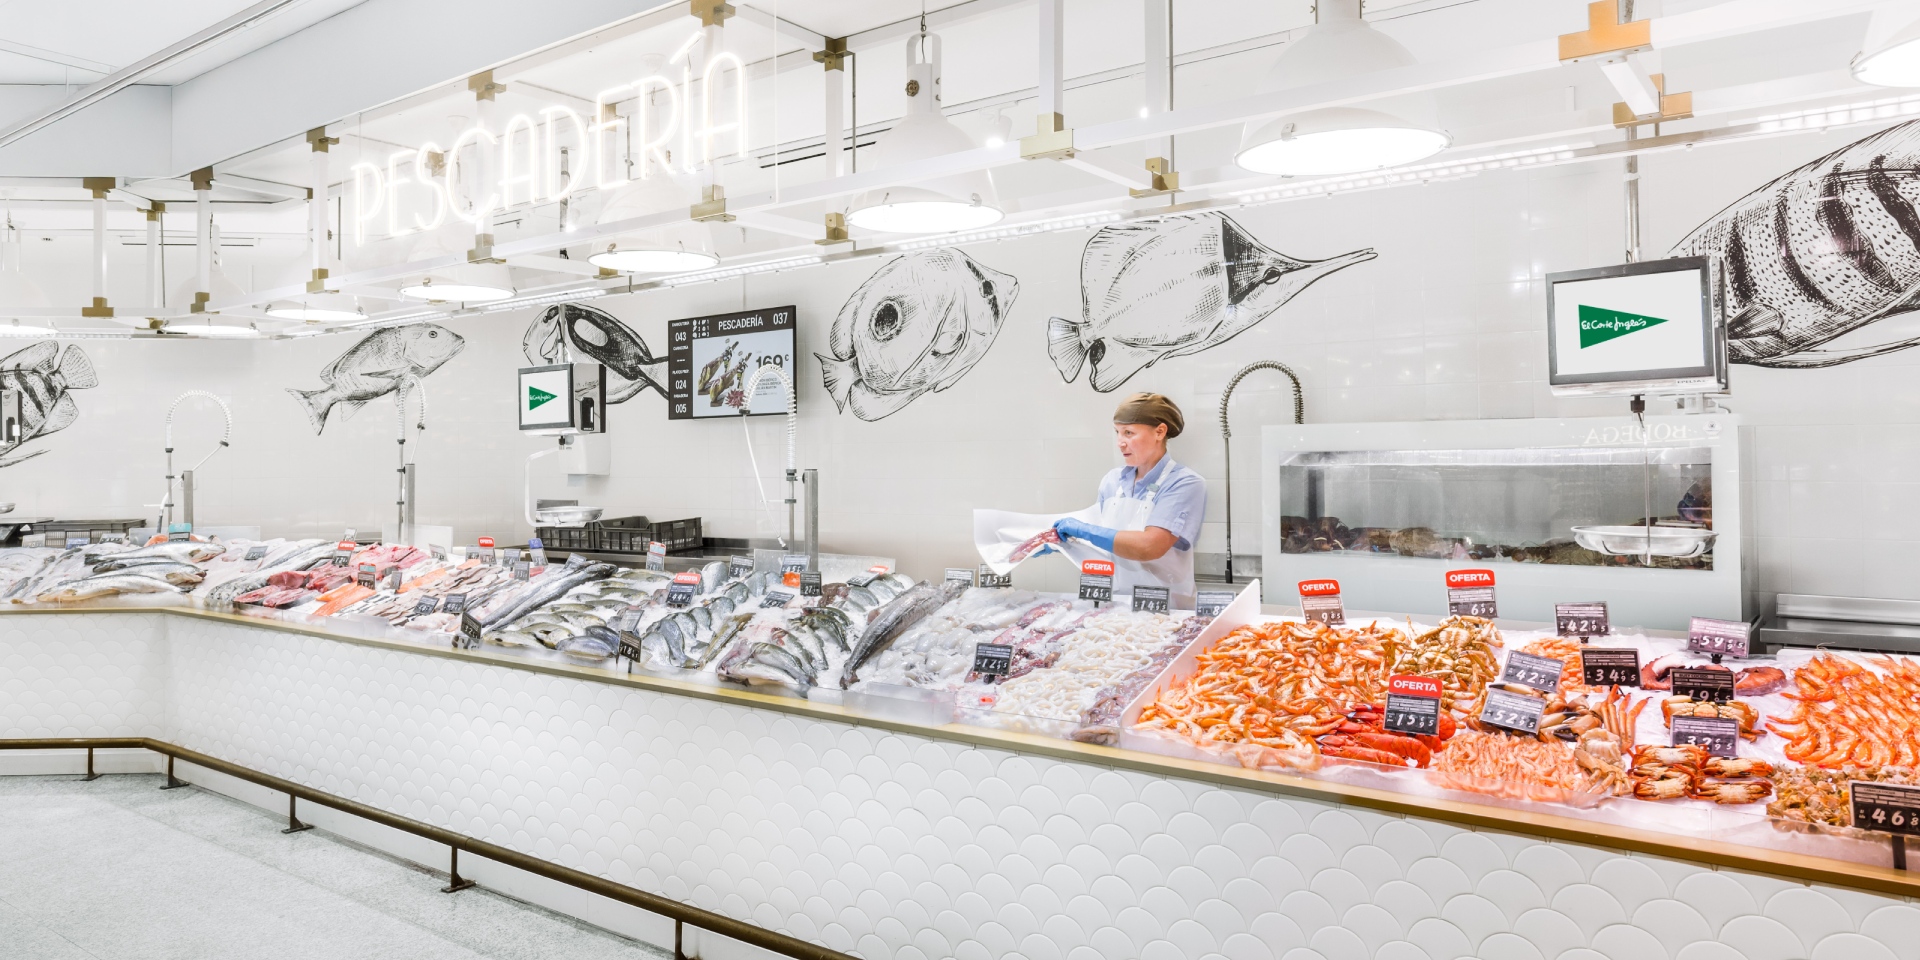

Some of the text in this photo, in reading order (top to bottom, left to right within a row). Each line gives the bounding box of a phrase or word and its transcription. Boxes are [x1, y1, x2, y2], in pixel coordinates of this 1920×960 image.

[351, 32, 749, 247] PESCADERÍA
[718, 312, 788, 331] PESCADERÍA 037
[1591, 320, 1613, 330] Corte
[675, 331, 687, 342] 043
[675, 380, 687, 389] 024
[675, 404, 687, 413] 005
[1083, 562, 1112, 572] OFERTA
[1450, 573, 1490, 582] OFERTA
[1086, 588, 1098, 598] 16
[1302, 583, 1336, 592] OFERTA
[1140, 600, 1155, 610] 14
[1471, 604, 1479, 615] 6
[1321, 612, 1328, 622] 9
[1567, 620, 1588, 632] 42
[1700, 635, 1724, 648] 59
[1516, 669, 1539, 684] 42
[1595, 669, 1619, 682] 34
[1393, 679, 1438, 692] OFERTA
[1397, 713, 1416, 726] 15
[1494, 710, 1518, 724] 52
[1871, 808, 1905, 826] 46
